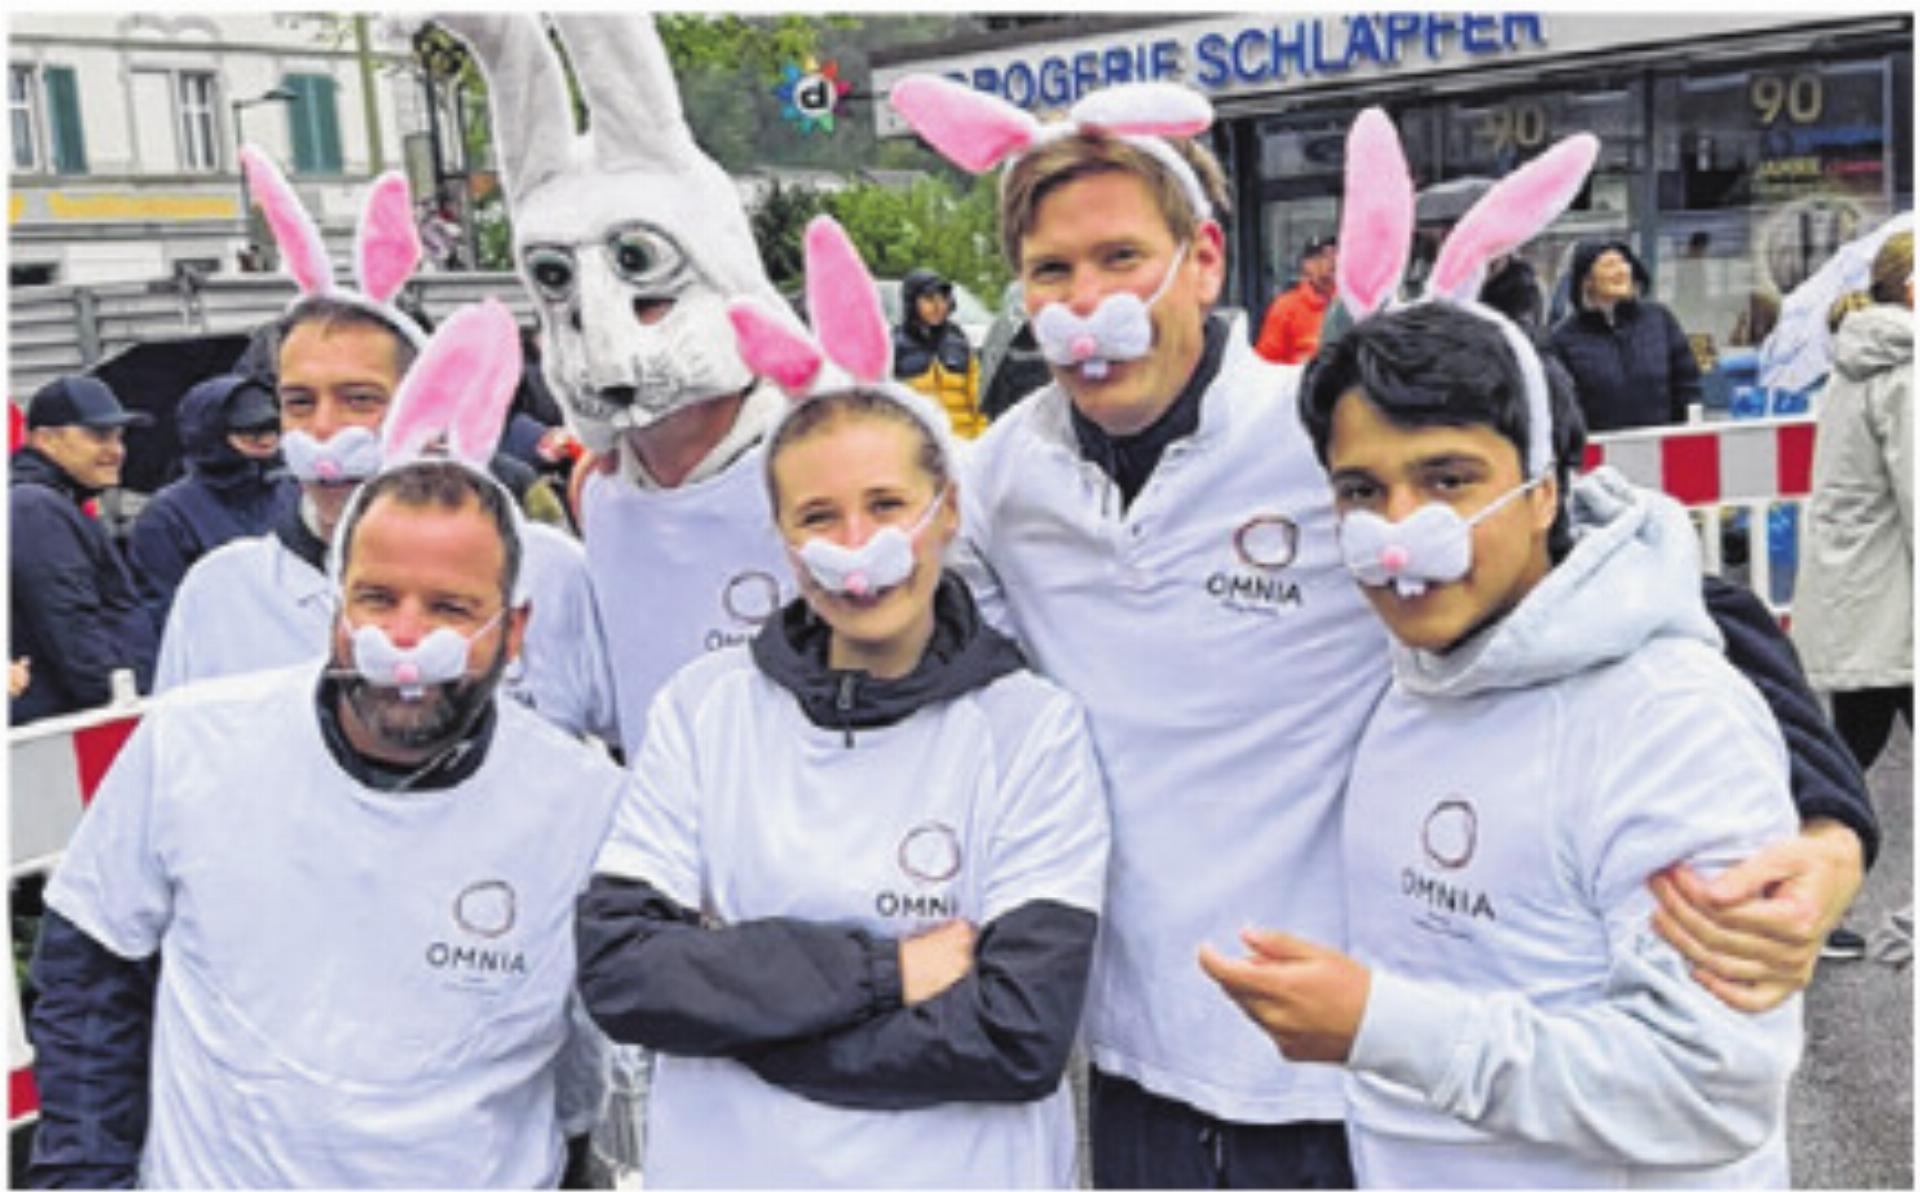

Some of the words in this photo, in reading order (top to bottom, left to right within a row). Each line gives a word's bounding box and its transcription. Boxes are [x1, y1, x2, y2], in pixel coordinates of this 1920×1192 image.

[944, 38, 1180, 110] ROGERIE
[1753, 75, 1822, 123] 90
[1206, 574, 1304, 606] OMNIA
[1401, 868, 1496, 921] OMNIA
[426, 942, 526, 973] OMNIA
